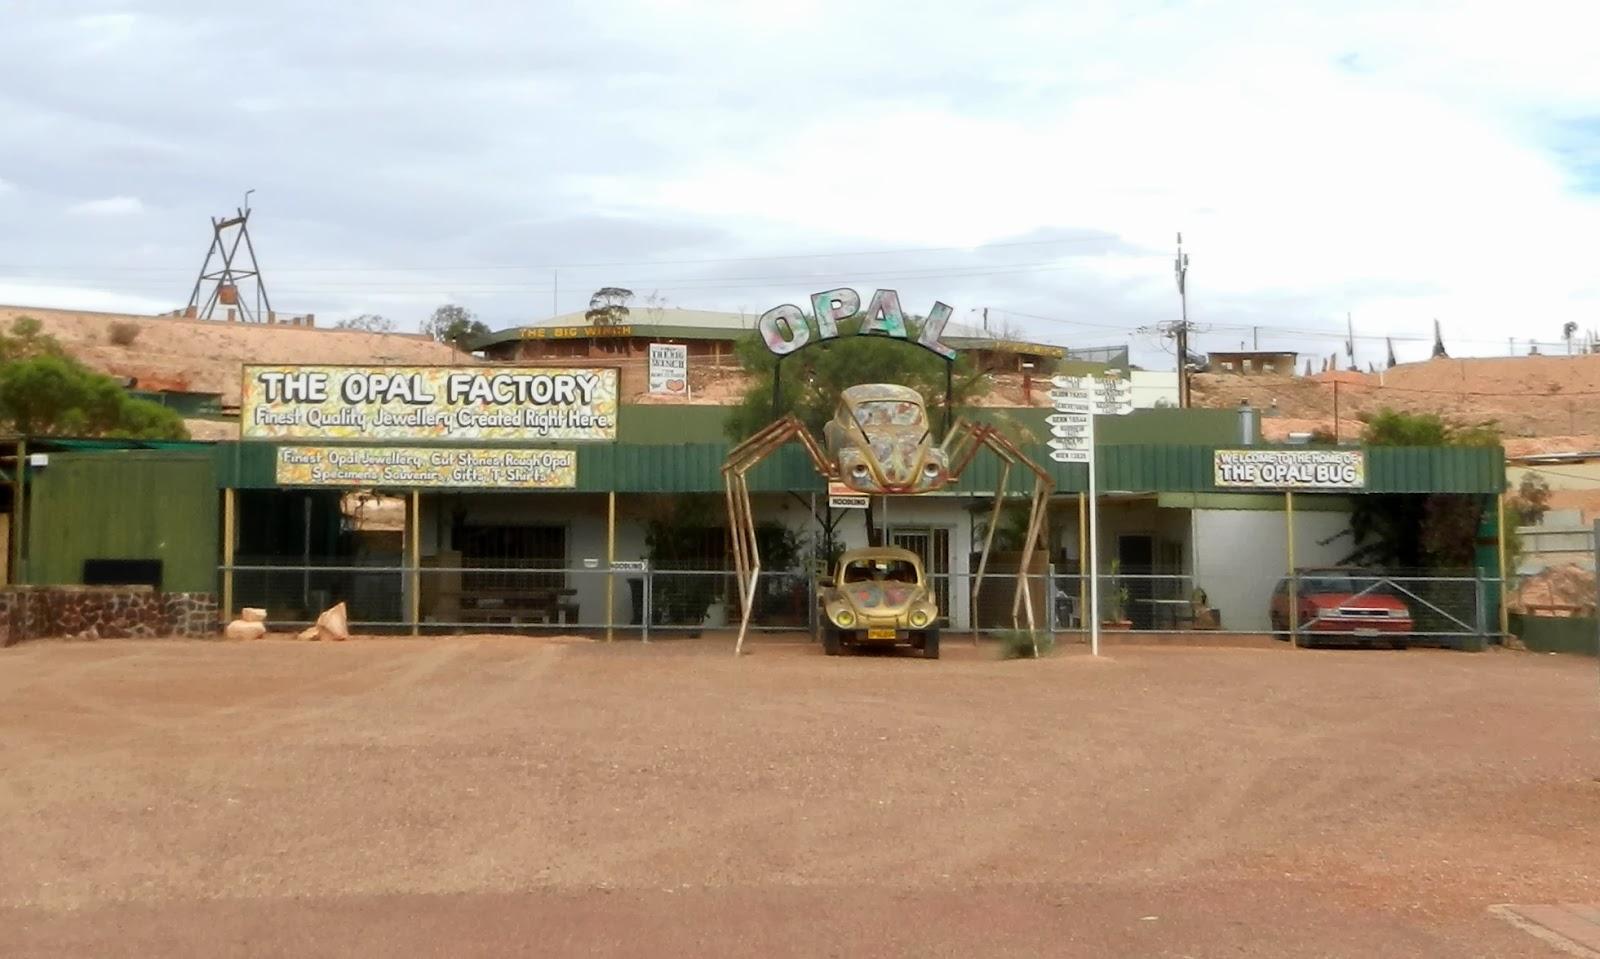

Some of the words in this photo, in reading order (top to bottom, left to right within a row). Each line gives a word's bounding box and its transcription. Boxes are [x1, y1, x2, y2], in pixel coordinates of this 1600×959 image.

[520, 328, 545, 338] THE
[554, 327, 577, 337] BIG
[584, 326, 631, 336] WINCH
[758, 287, 958, 361] OPAL
[258, 371, 328, 403] THE
[341, 372, 435, 405] OPAL
[447, 373, 600, 405] FACTORY
[255, 407, 300, 425] Finest
[307, 407, 367, 431] Quality
[372, 408, 453, 434] Jewellery
[456, 409, 521, 428] Created
[524, 409, 567, 436] Right
[567, 411, 613, 428] Here.
[283, 451, 322, 464] Finest
[328, 451, 360, 468] Opal
[431, 452, 454, 466] Cut
[505, 453, 541, 470] Rough
[542, 454, 571, 471] Opal
[1219, 453, 1276, 464] WELCOME
[1276, 453, 1291, 464] TO
[1291, 454, 1311, 464] THE
[1312, 454, 1341, 464] HOME
[1342, 454, 1357, 465] OF
[1219, 464, 1255, 481] THE
[1260, 464, 1312, 482] OPAL
[1314, 464, 1357, 483] BUG
